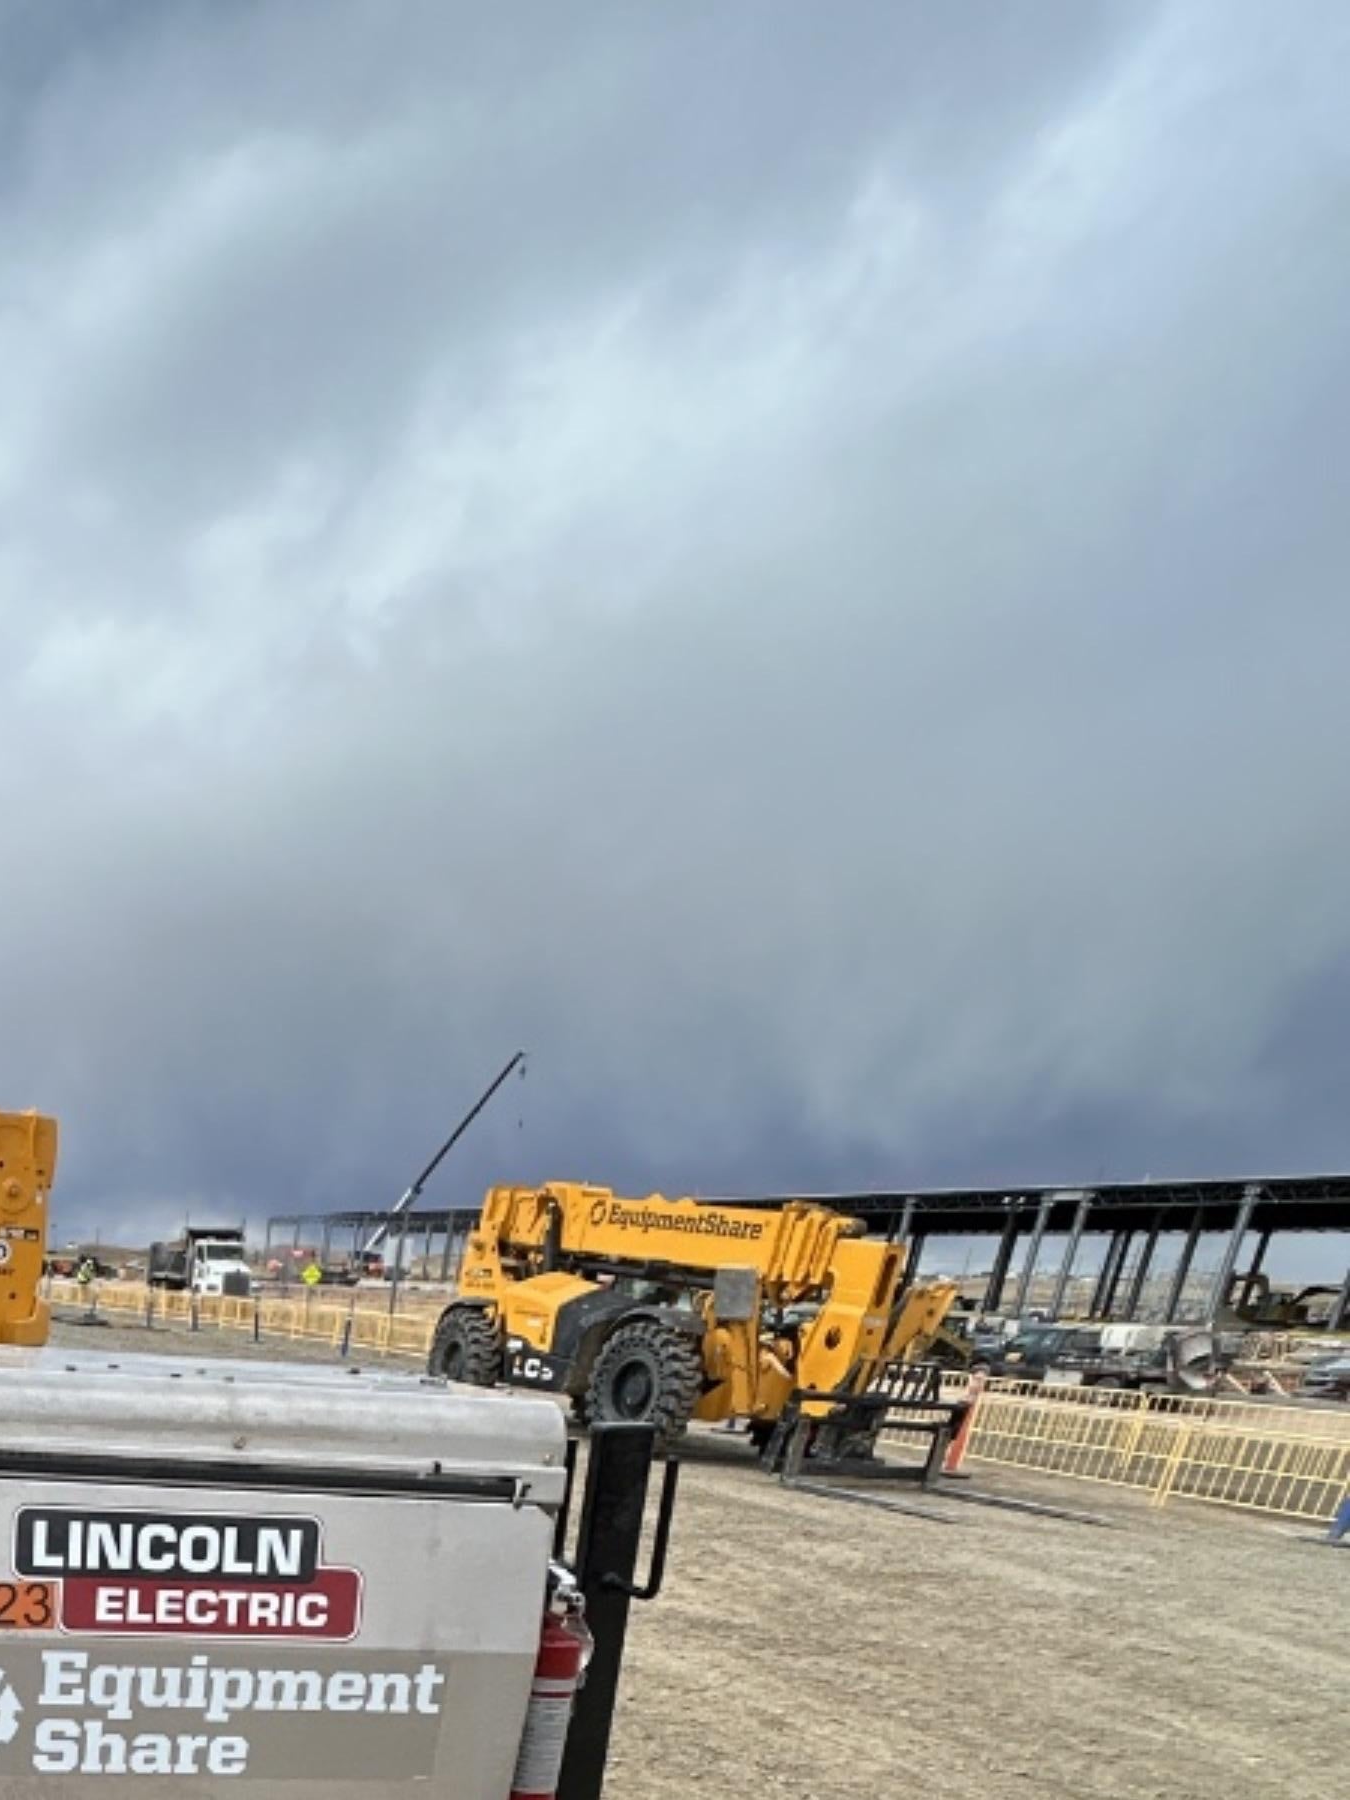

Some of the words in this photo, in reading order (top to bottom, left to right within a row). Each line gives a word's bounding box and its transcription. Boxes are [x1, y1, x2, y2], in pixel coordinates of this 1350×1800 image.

[608, 1202, 763, 1240] EquipmentShare
[30, 1520, 304, 1576] LINCOLN
[94, 1586, 329, 1628] ELECTRIC
[38, 1650, 445, 1723] Equipment
[32, 1718, 249, 1775] Share
